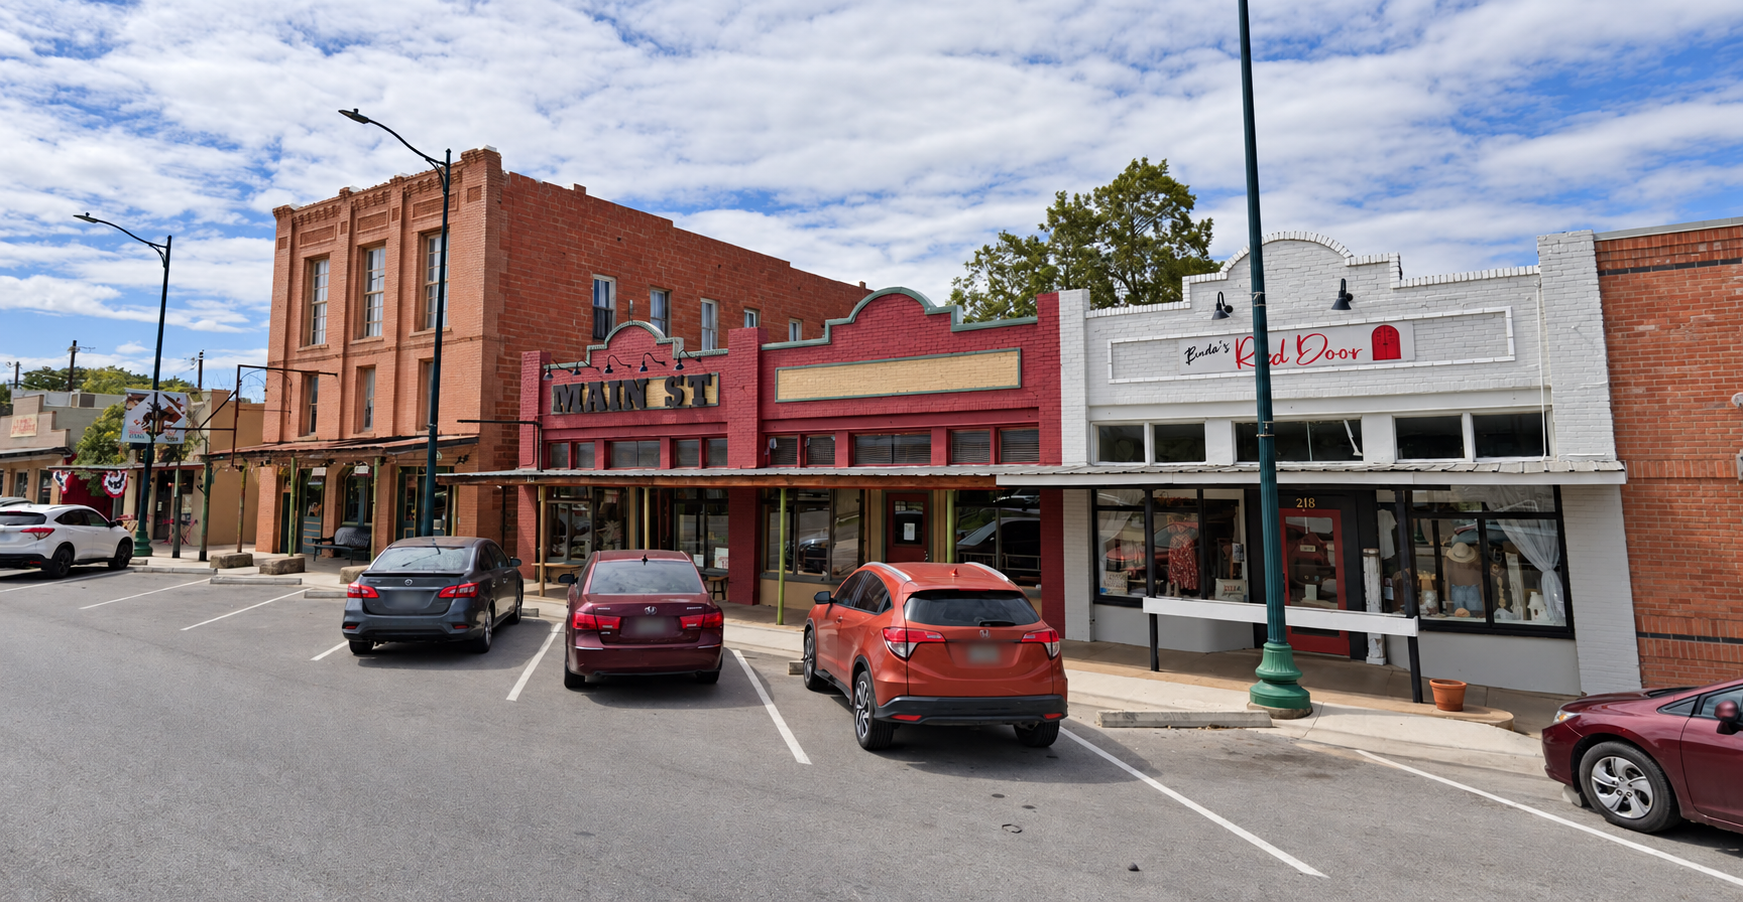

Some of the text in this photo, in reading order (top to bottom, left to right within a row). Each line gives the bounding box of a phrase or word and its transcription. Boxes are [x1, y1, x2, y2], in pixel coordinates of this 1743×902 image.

[1235, 336, 1289, 369] Rd
[1296, 333, 1363, 366] Door
[553, 373, 712, 413] MAIN ST
[1295, 497, 1316, 509] 218
